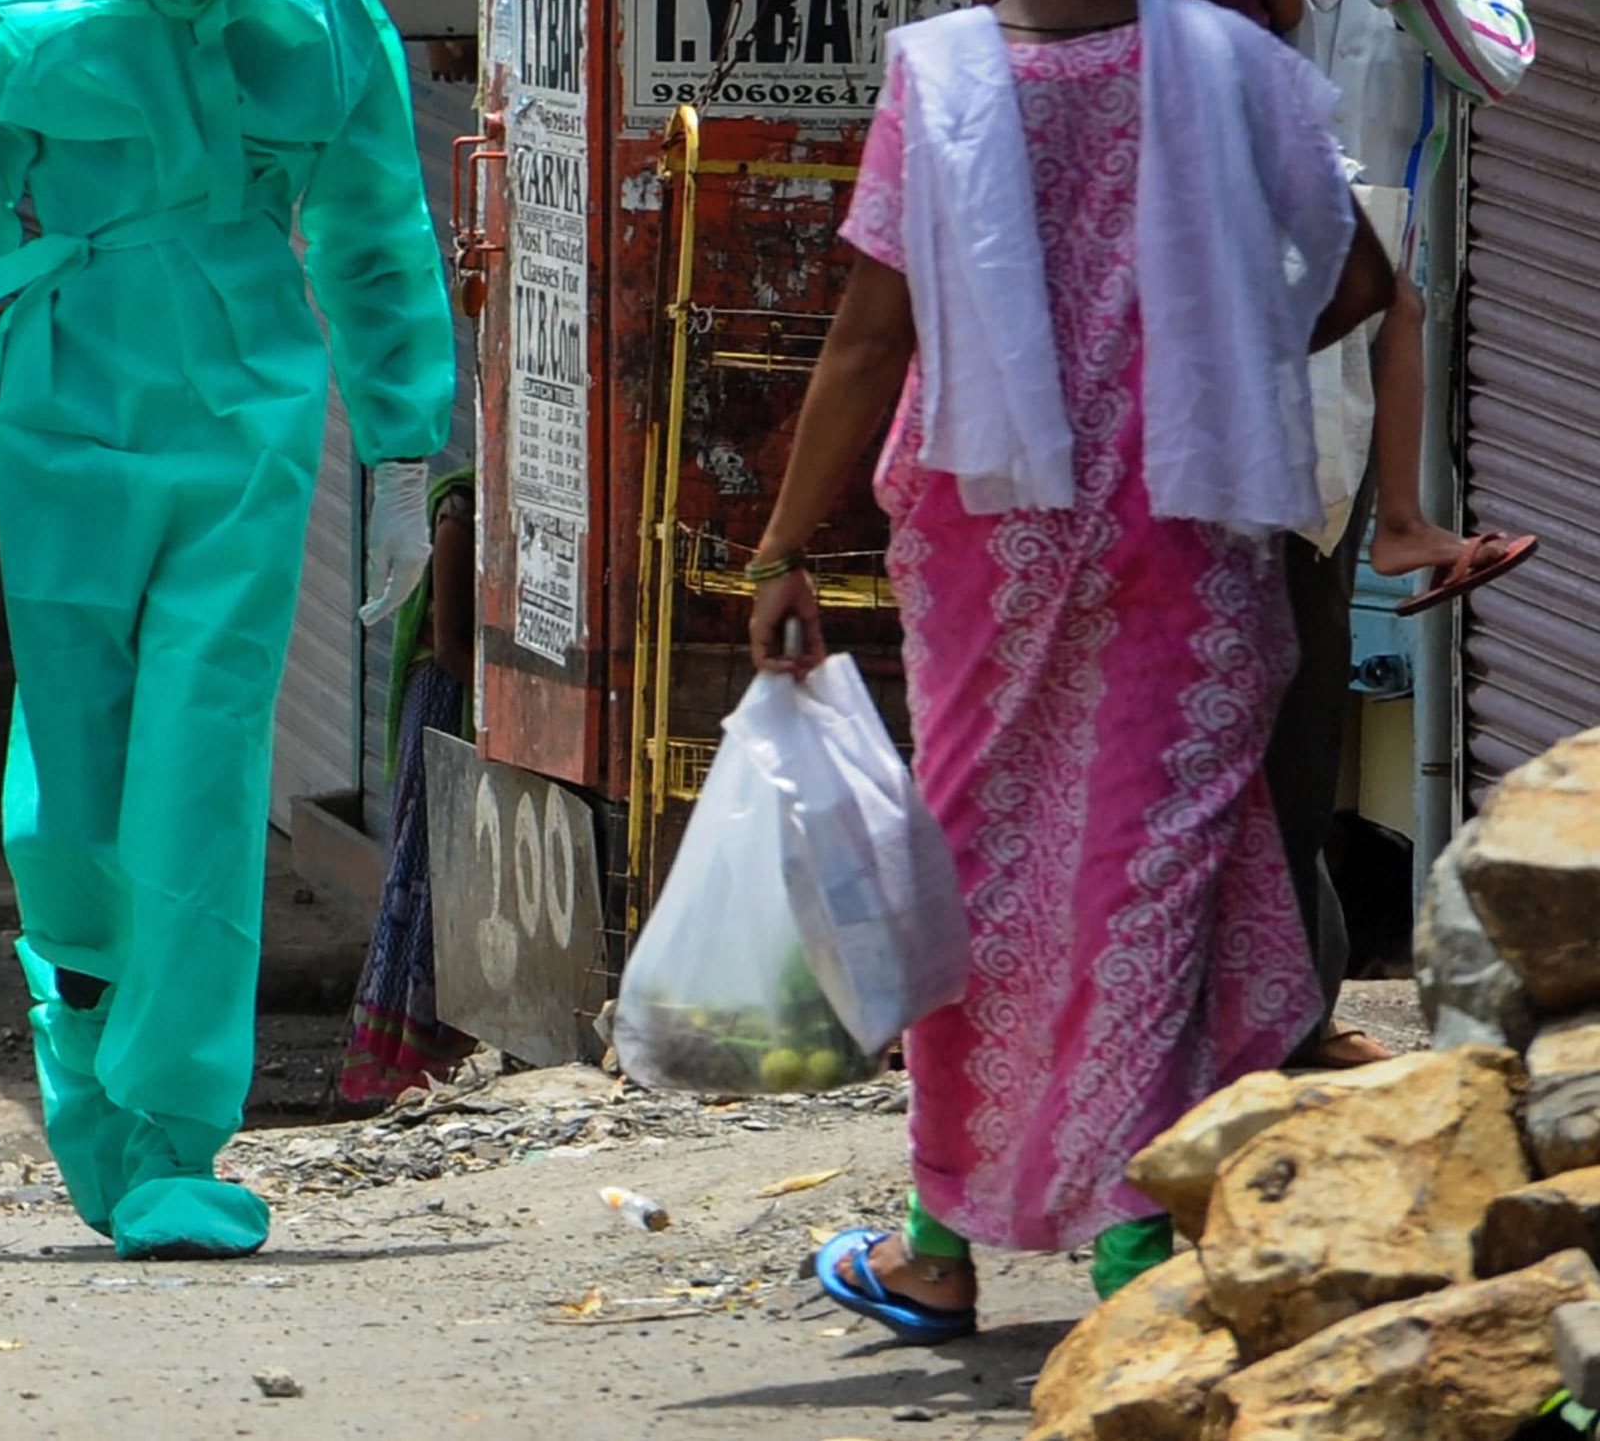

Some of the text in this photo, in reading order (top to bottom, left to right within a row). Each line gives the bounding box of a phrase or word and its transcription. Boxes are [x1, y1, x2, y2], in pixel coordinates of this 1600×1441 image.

[652, 84, 881, 105] 9820602647
[517, 149, 584, 215] VARMA
[516, 223, 584, 266] Most Trusted
[520, 255, 580, 294] Classes For
